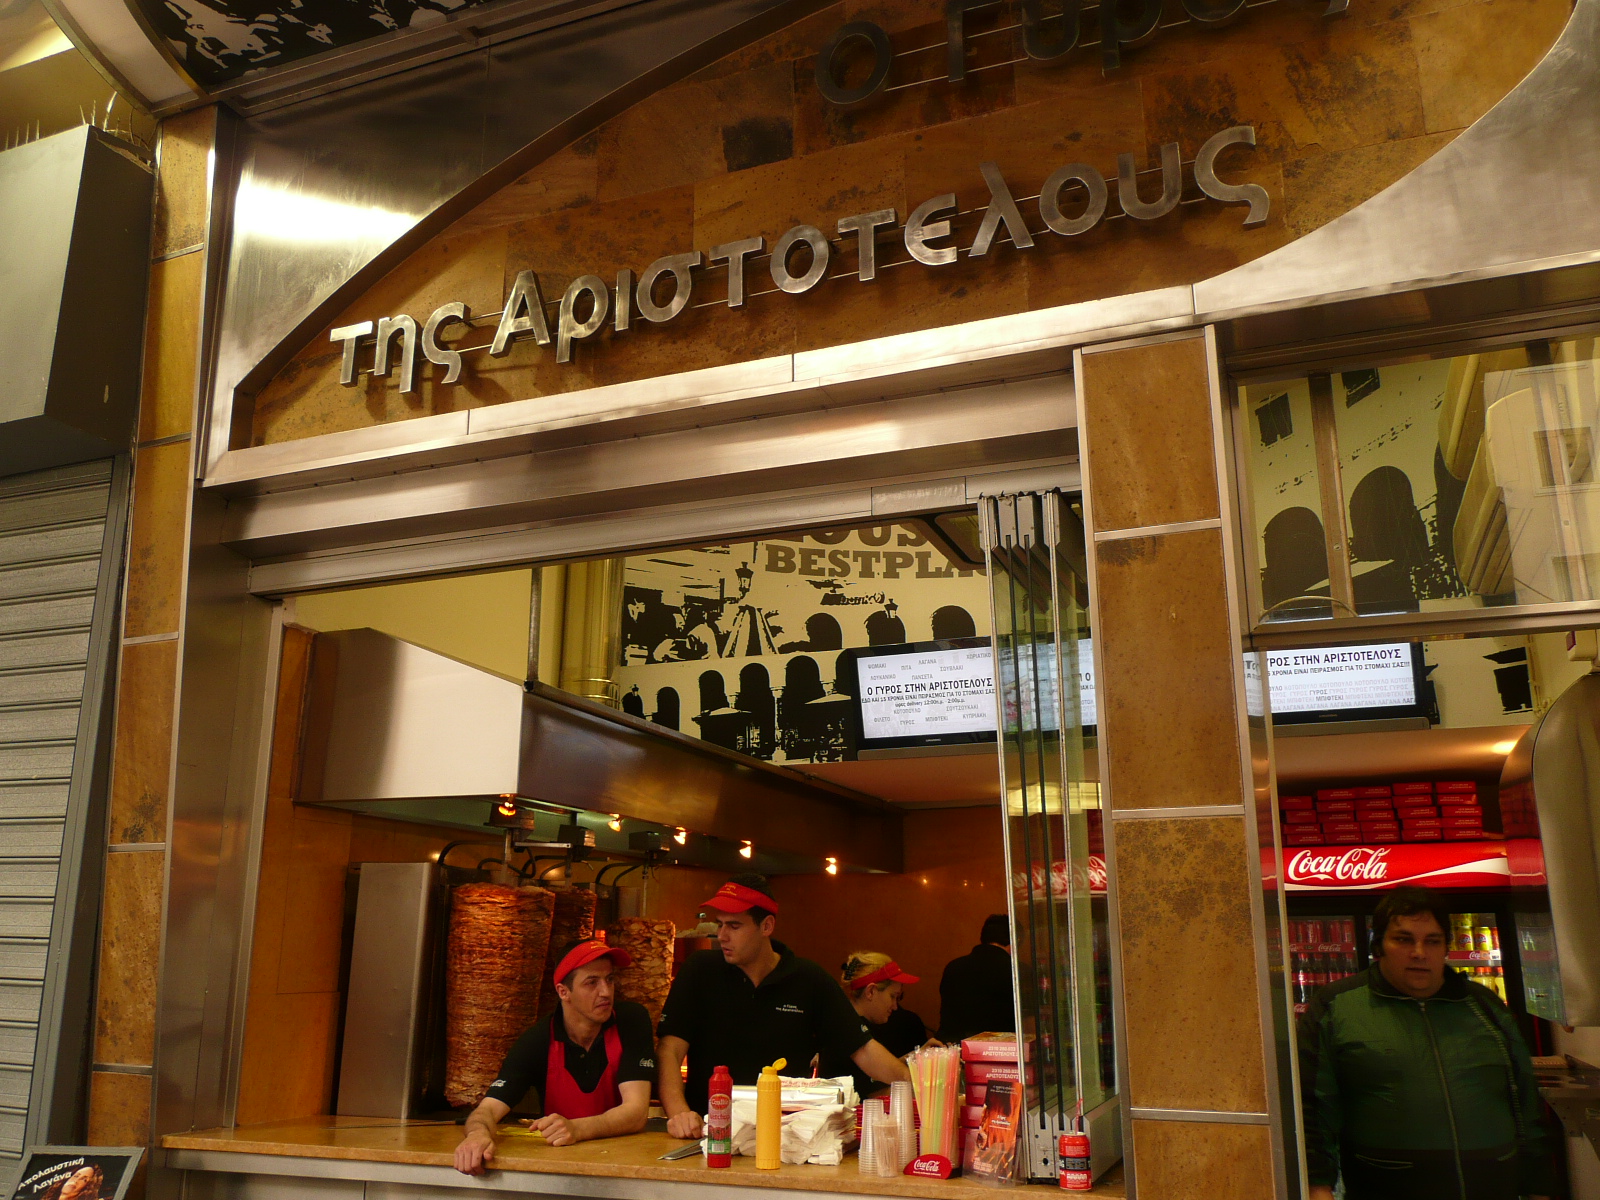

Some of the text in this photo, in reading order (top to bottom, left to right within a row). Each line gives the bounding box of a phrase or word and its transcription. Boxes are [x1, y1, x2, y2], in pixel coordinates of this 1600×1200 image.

[330, 125, 1270, 394] της Αριστοτελους
[918, 658, 937, 666] ΛΑΓΑΝΑ
[1293, 654, 1320, 666] ΣΤΗΝ
[1323, 648, 1402, 664] ΑΡΙΣΤΟΤΕΛΟΥΣ
[1272, 668, 1293, 676] ΧΡΟΝΙΑ
[1293, 667, 1309, 675] ΕΙΝΑΙ
[1310, 665, 1344, 674] ΠΕΙΡΑΣΜΟΣ
[1364, 662, 1391, 670] ΣΤΟΜΑΧΙ
[867, 677, 993, 696] Ο ΓΥΡΟΣ ΣΤΗΝ ΑΡΙΣΤΟΤΕΛΟΥΣ
[1319, 680, 1353, 689] ΚΟΤΟΠΟΥΛΟ
[1355, 678, 1389, 686] ΚΟΤΟΠΟΥΛΟ
[888, 694, 904, 702] ΧΡΟΝΙΑ
[918, 692, 946, 700] ΠΕΙΡΑΣΜΟΣ
[906, 700, 923, 708] delivery
[1282, 703, 1305, 711] ΛΑΓΑΝΑ
[1306, 702, 1328, 710] ΛΑΓΑΝΑ
[1287, 847, 1392, 881] Coca-Cola
[18, 1156, 85, 1191] Απολαυστική
[32, 1171, 73, 1194] Λαγάνα
